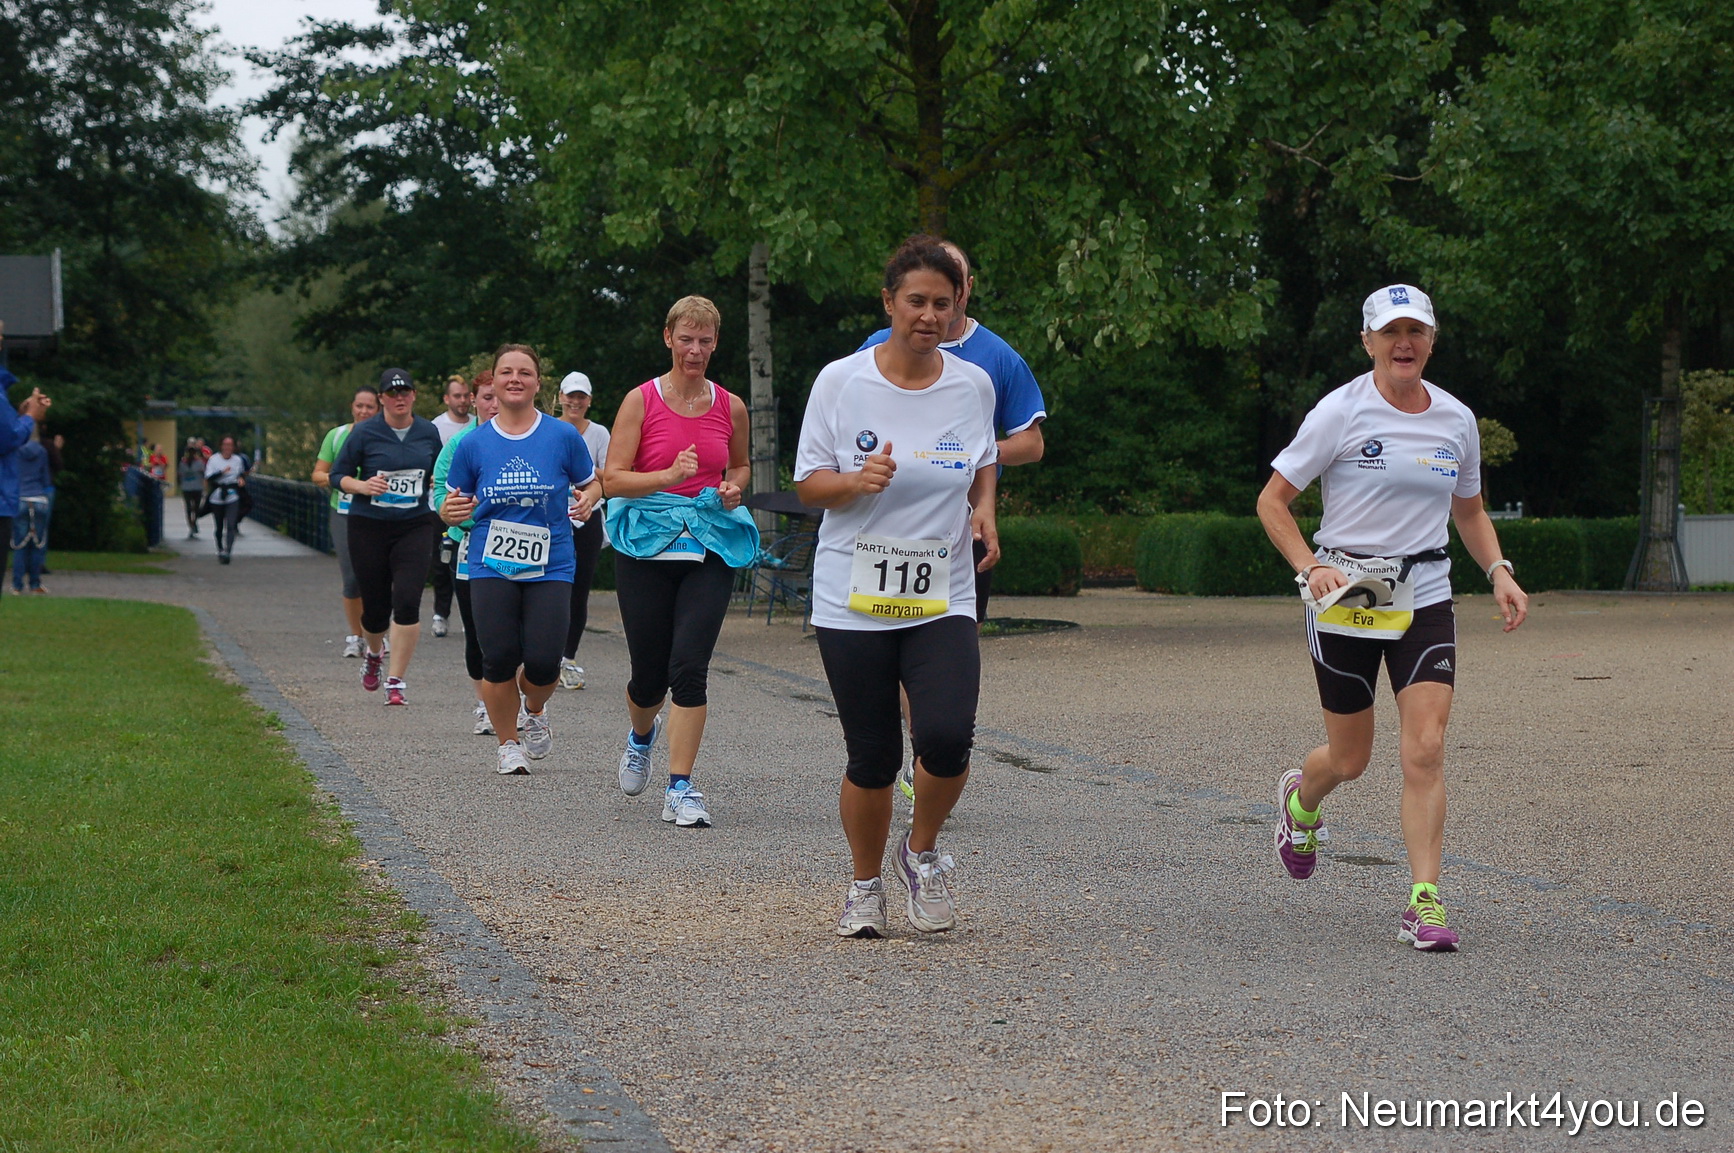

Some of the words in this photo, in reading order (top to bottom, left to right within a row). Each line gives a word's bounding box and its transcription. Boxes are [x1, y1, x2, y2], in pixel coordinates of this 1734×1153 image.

[913, 451, 928, 460] 14.
[384, 478, 416, 495] 551
[482, 486, 498, 497] 13.
[491, 525, 509, 534] PARTL
[510, 529, 540, 539] Neumarkt
[491, 535, 543, 562] 2250
[856, 542, 889, 555] PARTL
[891, 547, 935, 558] Neumarkt
[496, 562, 524, 574] Susan
[1327, 555, 1355, 569] PARTL
[1356, 563, 1399, 574] Neumarkt
[873, 559, 932, 595] 118
[871, 603, 923, 618] maryam
[1353, 612, 1374, 626] Eva
